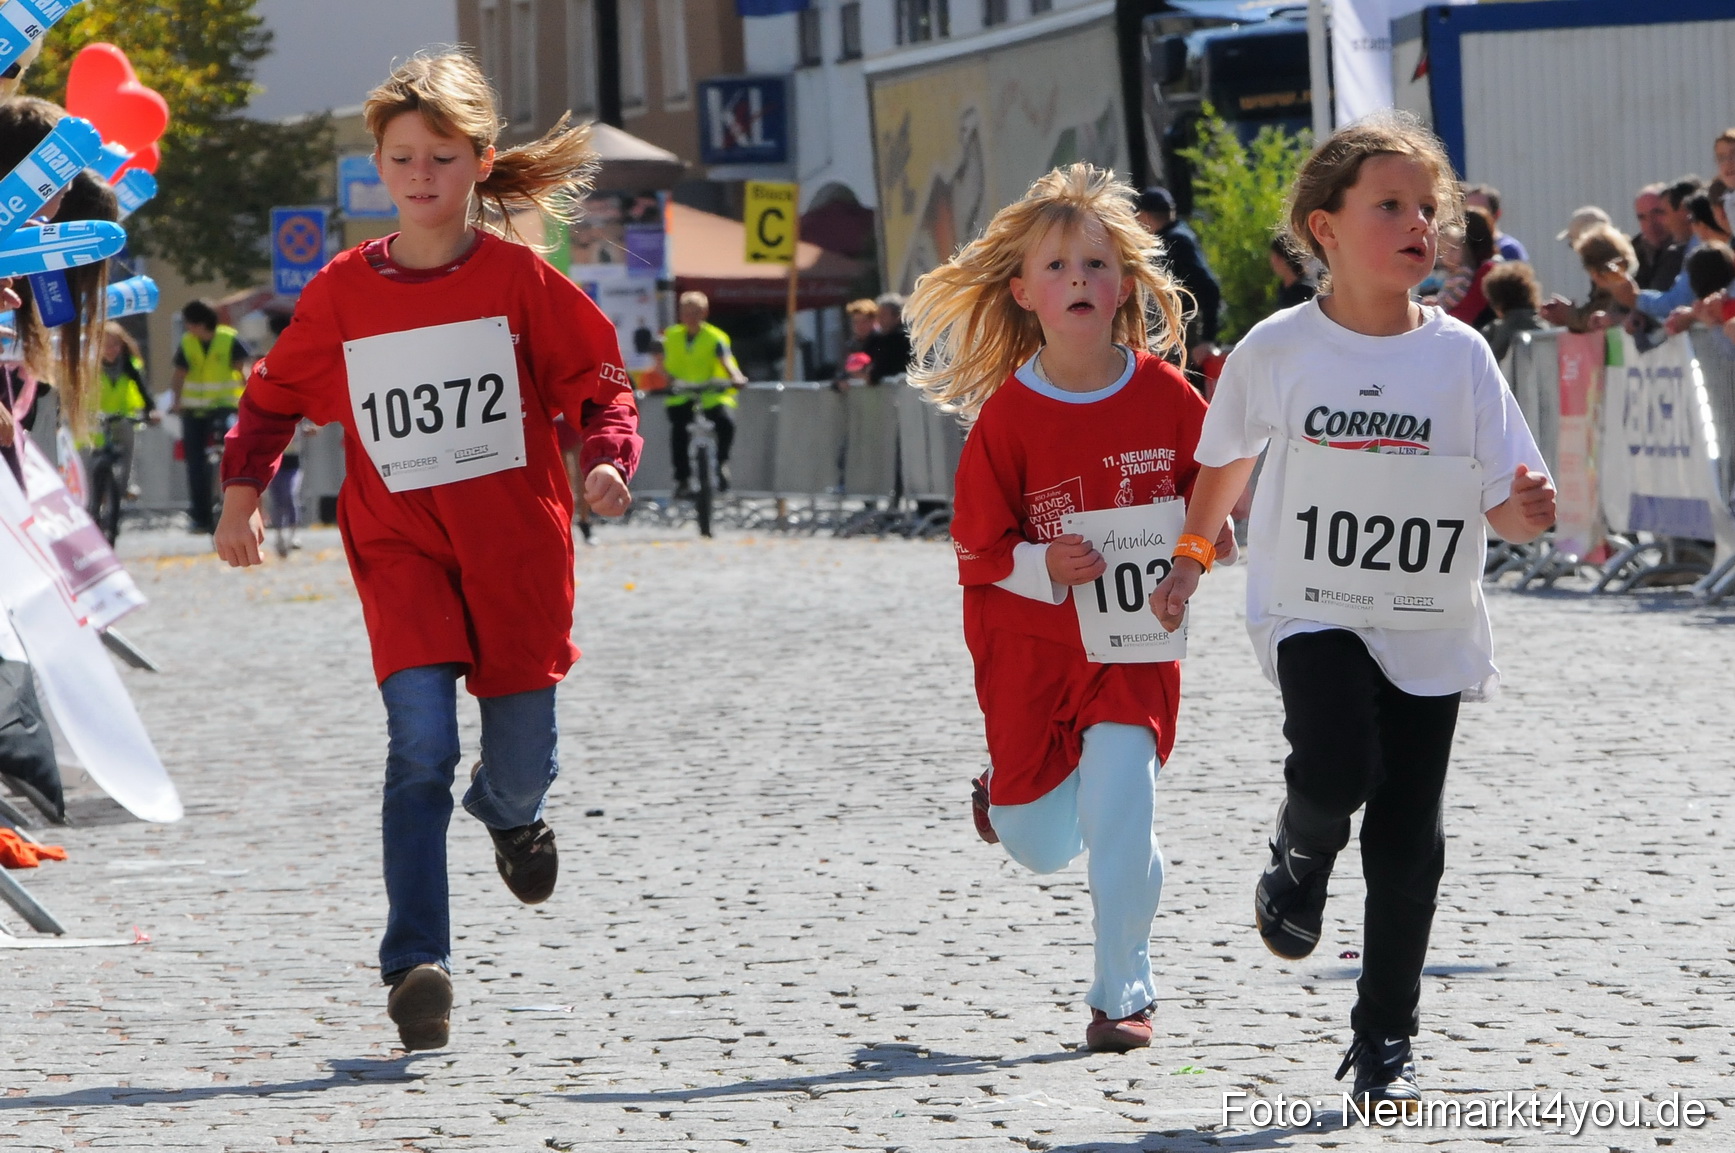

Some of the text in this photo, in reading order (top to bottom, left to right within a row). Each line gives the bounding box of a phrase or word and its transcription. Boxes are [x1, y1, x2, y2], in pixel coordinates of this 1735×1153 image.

[24, 24, 43, 40] dsl
[37, 141, 82, 181] maxi
[37, 183, 56, 201] dsl
[758, 208, 784, 248] C
[1359, 389, 1380, 397] PUMA
[361, 373, 507, 442] 10372
[1304, 405, 1432, 442] CORRIDA
[391, 456, 438, 470] PFLEIDERER
[1102, 455, 1120, 469] 11.
[1029, 493, 1072, 515] IMMER
[1035, 520, 1064, 541] NE
[1101, 529, 1165, 553] Annika
[1296, 505, 1465, 574] 10207
[1321, 589, 1434, 606] PFLEIDERER BOCK
[1122, 632, 1170, 643] PFLEIDERER
